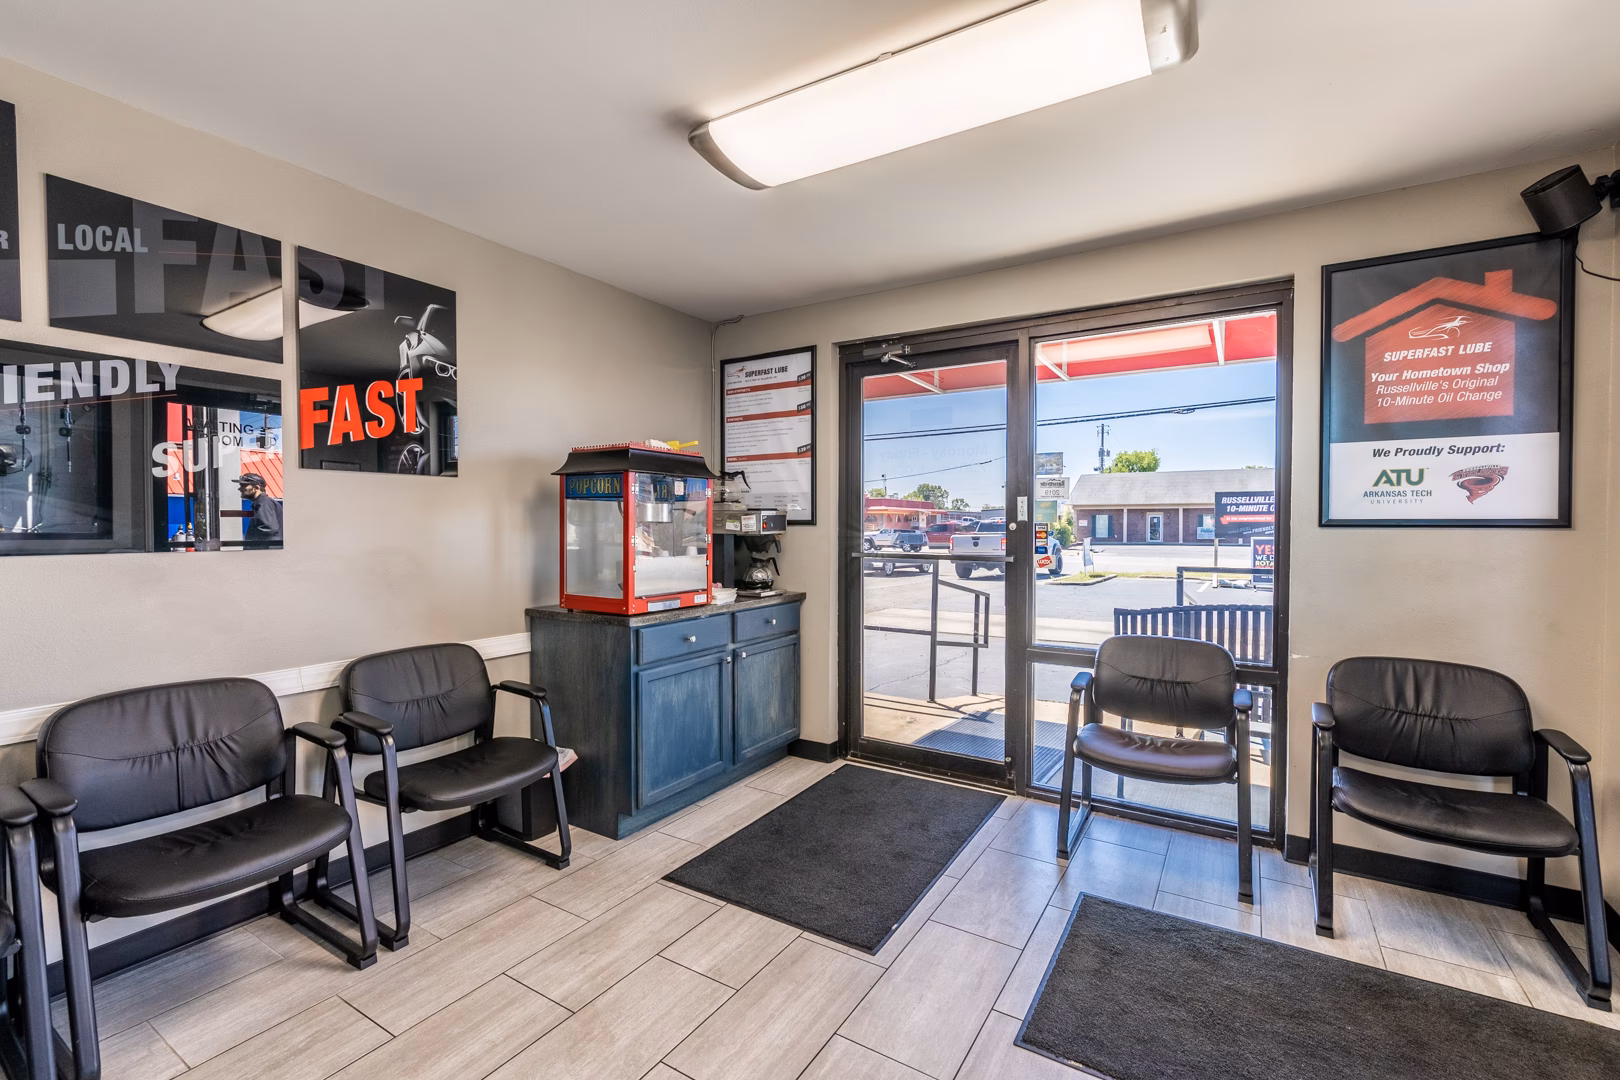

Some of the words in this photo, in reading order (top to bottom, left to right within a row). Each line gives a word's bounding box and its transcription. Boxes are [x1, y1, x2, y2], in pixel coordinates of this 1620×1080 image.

[57, 223, 149, 254] LOCAL
[1383, 346, 1455, 362] SUPERFAST
[1458, 342, 1493, 355] LUBE
[744, 367, 774, 378] SUPERFAST
[774, 365, 788, 374] LUBE
[1371, 372, 1399, 383] Your
[1401, 366, 1471, 380] Hometown
[1475, 362, 1510, 374] Shop
[2, 358, 181, 405] IENDLY
[1376, 379, 1449, 395] Russellville's
[1452, 376, 1499, 390] Original
[1377, 394, 1438, 408] 10-Minute
[1437, 392, 1454, 403] Oil
[1456, 390, 1503, 402] Change
[300, 378, 424, 450] FAST
[1372, 447, 1391, 458] We
[1394, 445, 1444, 457] Proudly
[1447, 443, 1505, 456] Support:
[569, 477, 621, 495] POPCORN
[1372, 468, 1425, 487] ATU
[1363, 489, 1407, 498] ARKANSAS
[1410, 489, 1432, 497] TECH
[1226, 504, 1267, 512] 10-MINUTE
